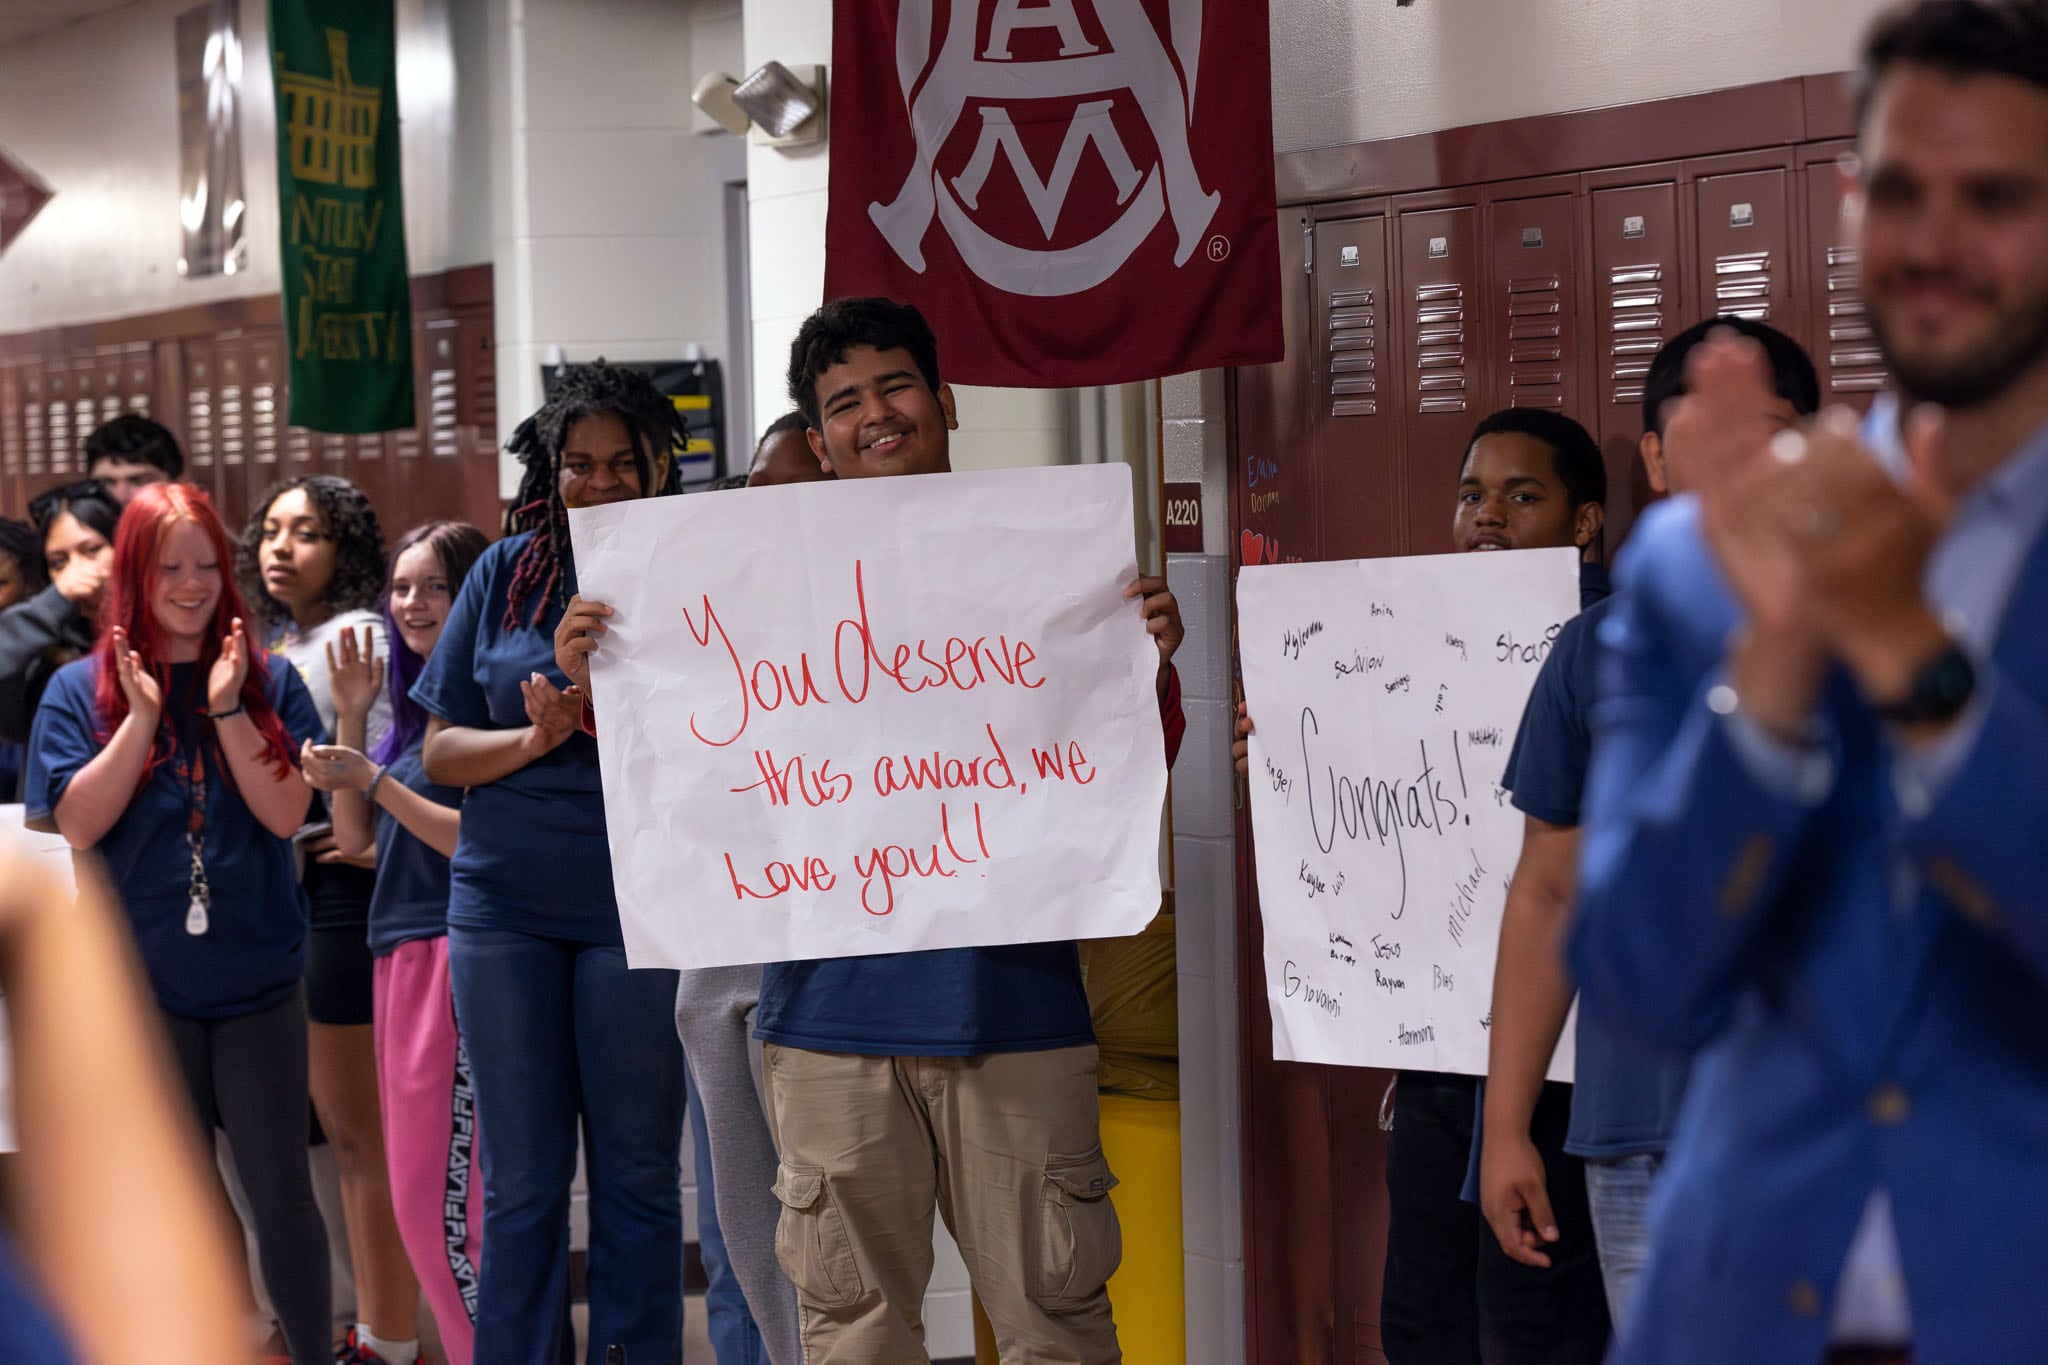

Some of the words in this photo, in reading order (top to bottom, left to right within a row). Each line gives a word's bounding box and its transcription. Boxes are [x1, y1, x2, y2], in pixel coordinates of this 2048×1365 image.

[1166, 500, 1198, 525] A220
[683, 595, 828, 747] You
[835, 560, 1046, 703] deserve
[730, 751, 853, 807] this
[874, 723, 1028, 796] award,
[1032, 741, 1096, 785] we
[1301, 707, 1470, 920] Congrats!
[855, 802, 990, 916] you!!
